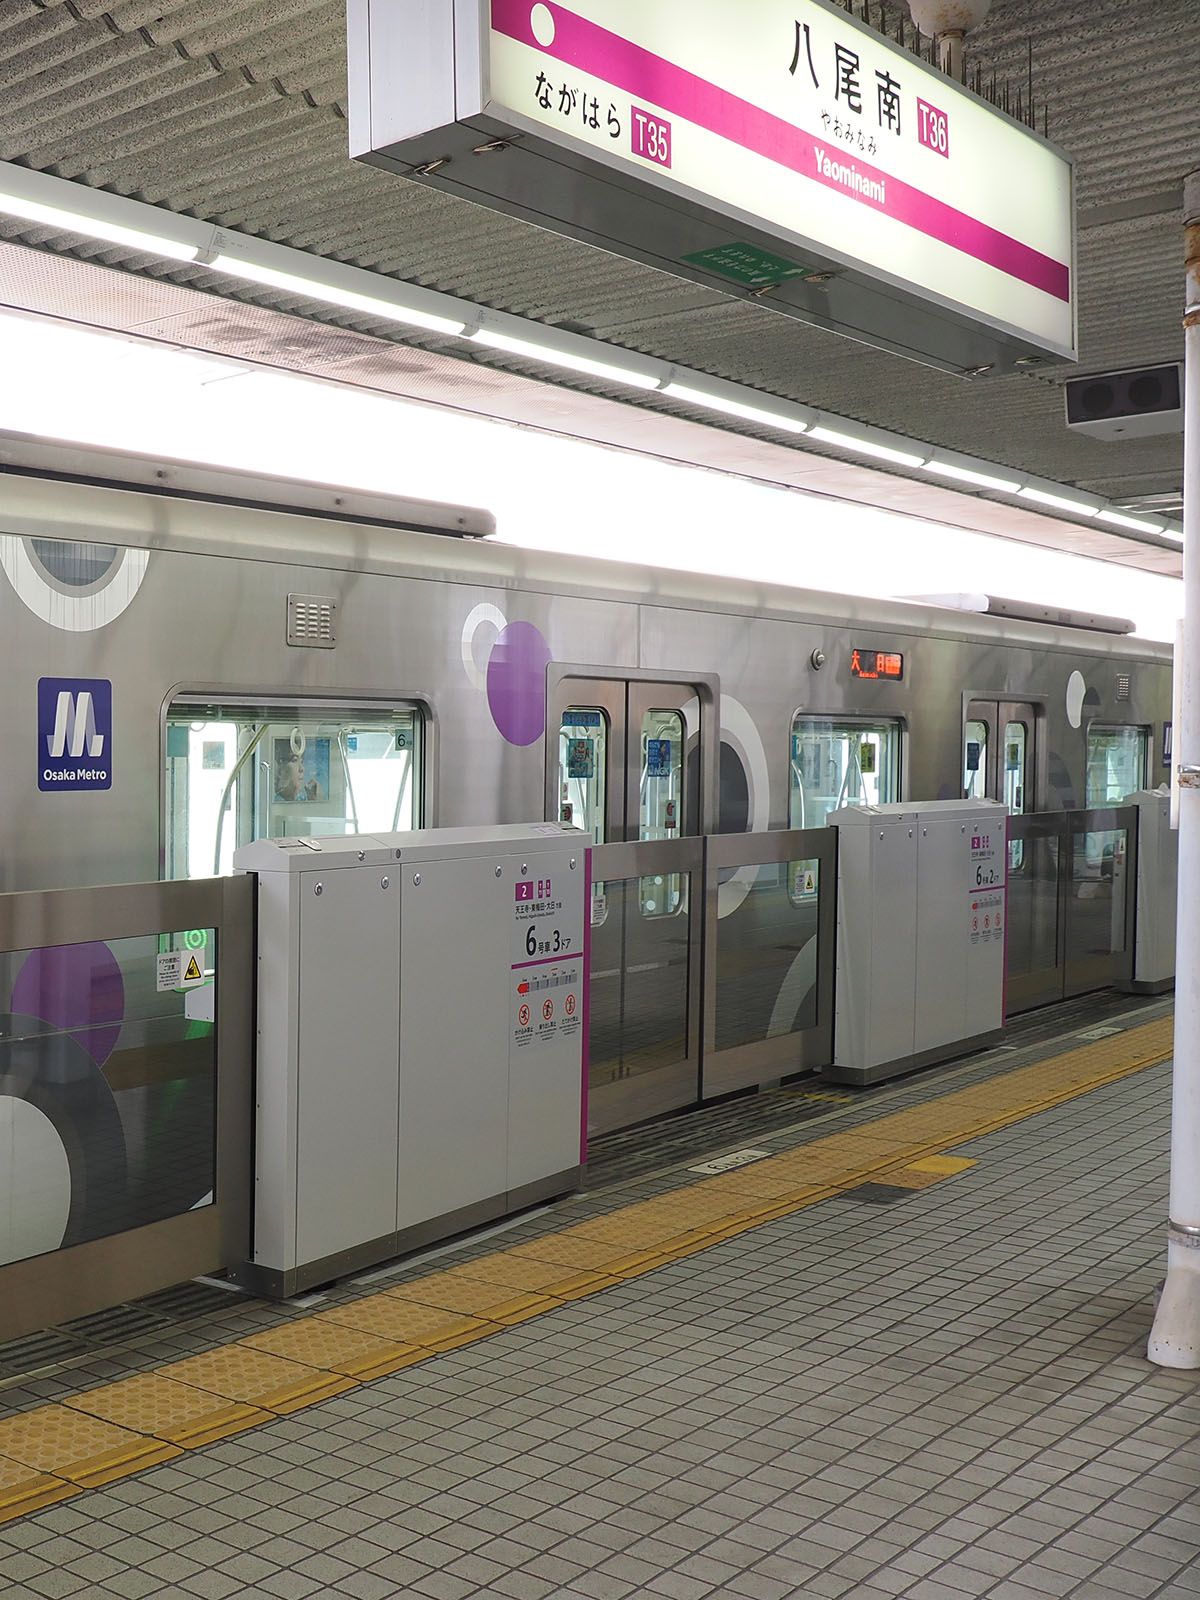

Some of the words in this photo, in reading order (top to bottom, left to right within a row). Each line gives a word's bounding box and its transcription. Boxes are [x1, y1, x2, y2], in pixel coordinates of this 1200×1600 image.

[789, 20, 901, 136] 八尾南
[535, 72, 621, 138] ながはら
[919, 103, 947, 153] T36
[635, 113, 668, 162] T35
[821, 108, 877, 156] やおみなみ
[814, 146, 886, 204] Yaominami
[43, 768, 76, 781] Osaka
[76, 768, 107, 781] Metro
[521, 885, 527, 898] 2
